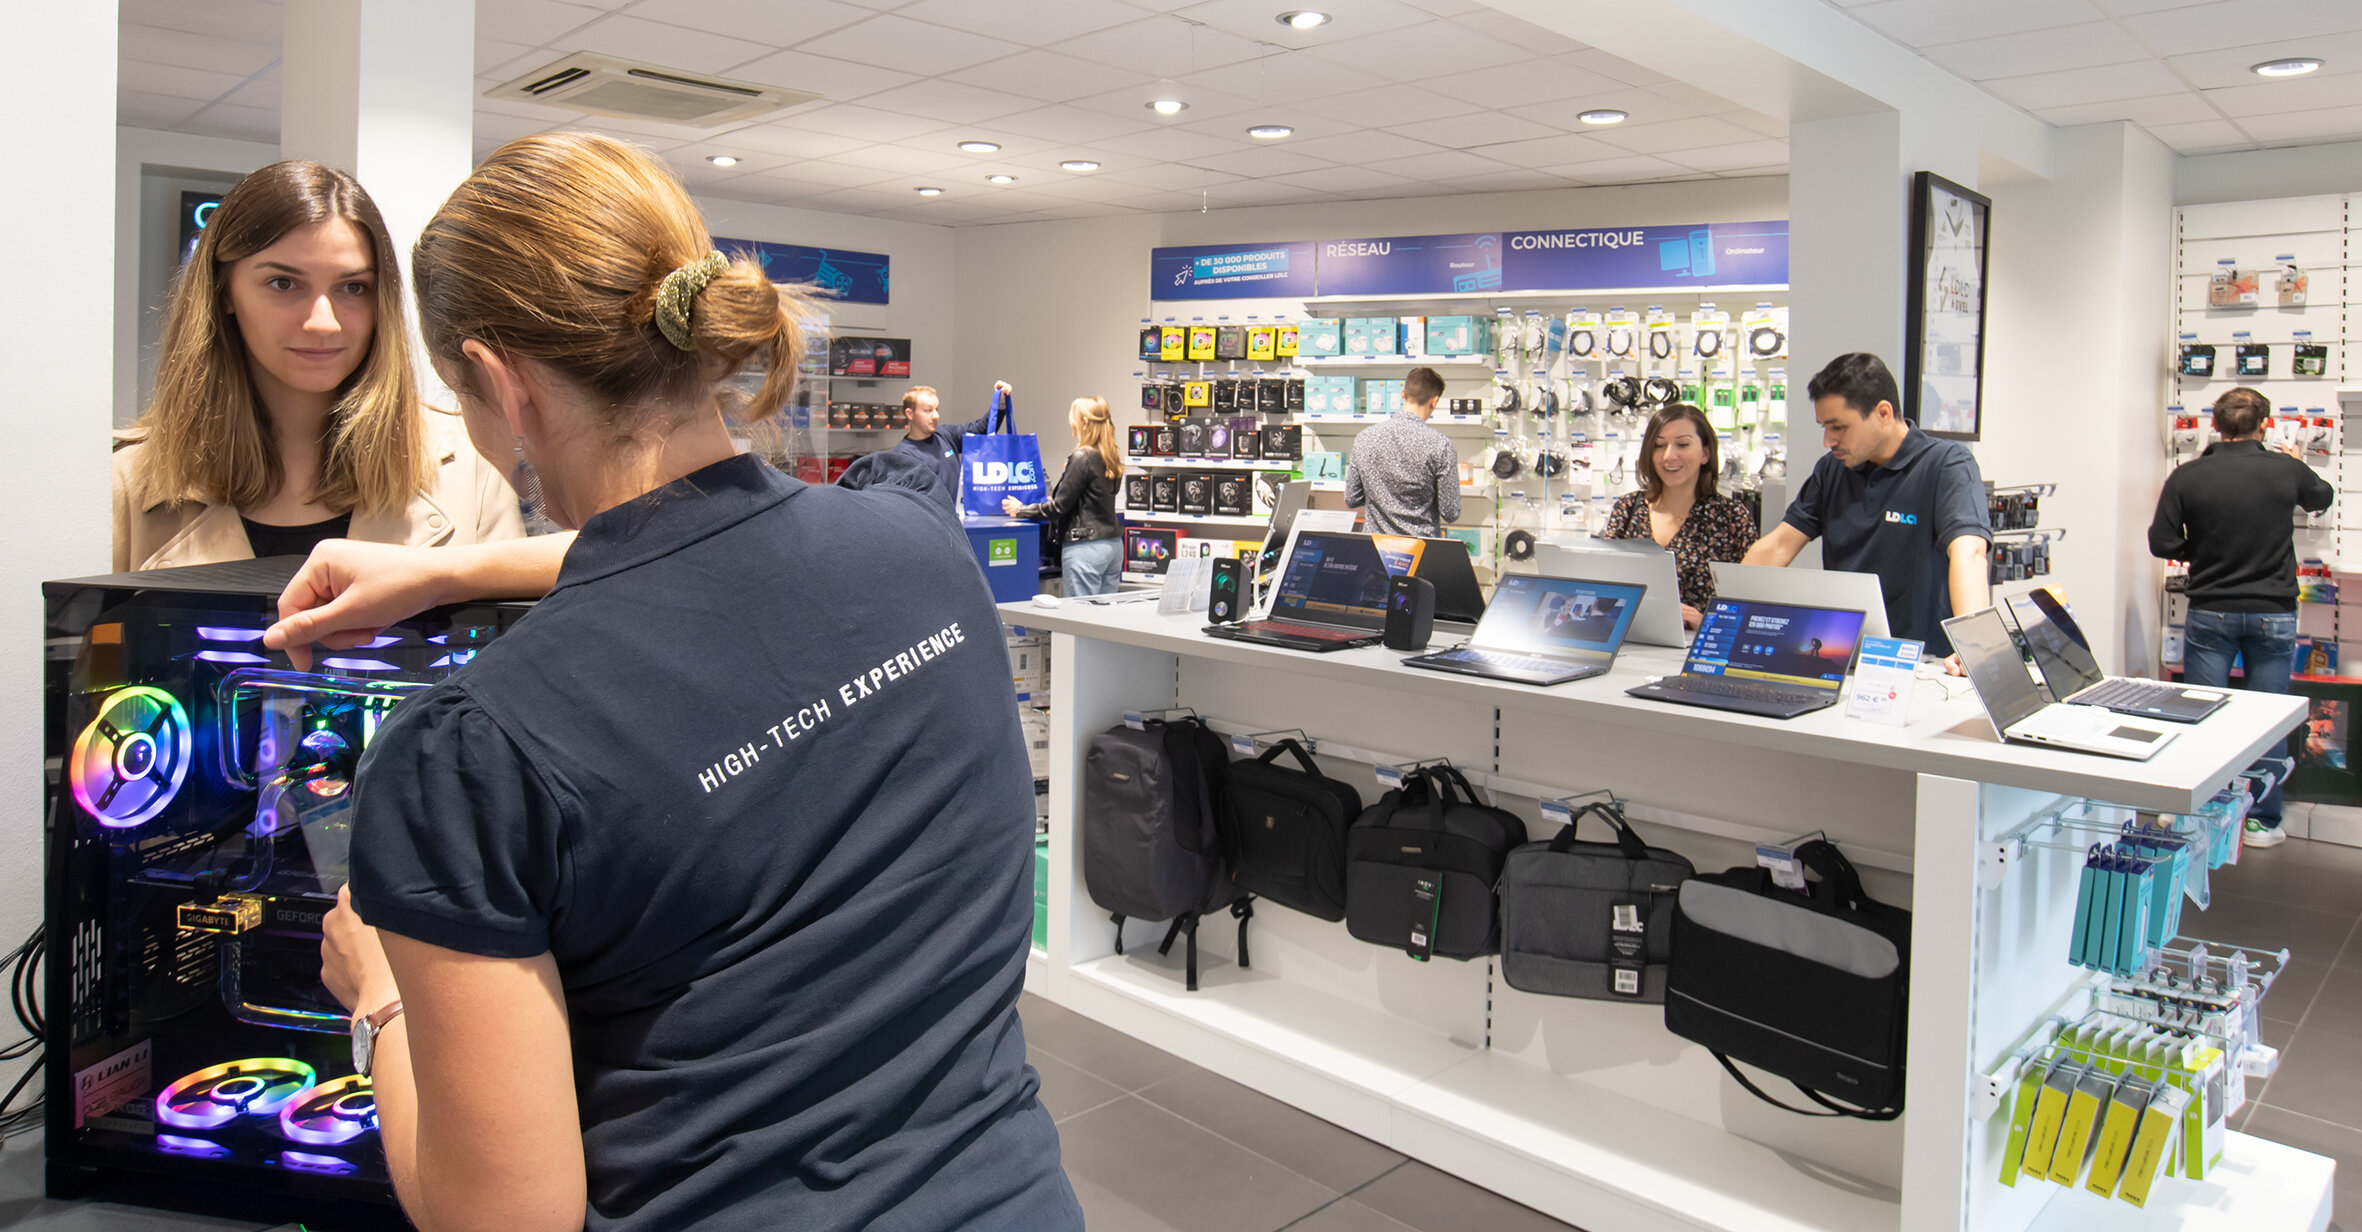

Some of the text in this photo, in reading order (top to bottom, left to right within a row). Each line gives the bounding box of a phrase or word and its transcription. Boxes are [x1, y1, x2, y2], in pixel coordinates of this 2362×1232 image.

[1511, 231, 1644, 250] CONNECTIQUE
[1326, 241, 1391, 257] RÉSEAU
[1725, 247, 1765, 255] Ordinateur
[1201, 256, 1212, 266] DE
[1213, 256, 1224, 265] 30
[1225, 255, 1242, 265] 000
[1243, 251, 1286, 263] PRODUITS
[1213, 262, 1267, 274] DISPONIBLES
[1242, 273, 1273, 282] CONSEILLER
[972, 461, 1029, 485] LDLC
[698, 622, 965, 793] HIGH-TECH EXPERIENCE
[186, 913, 230, 926] GIGABYTE
[276, 909, 323, 924] GEFORC
[98, 1048, 148, 1081] LIAN LI
